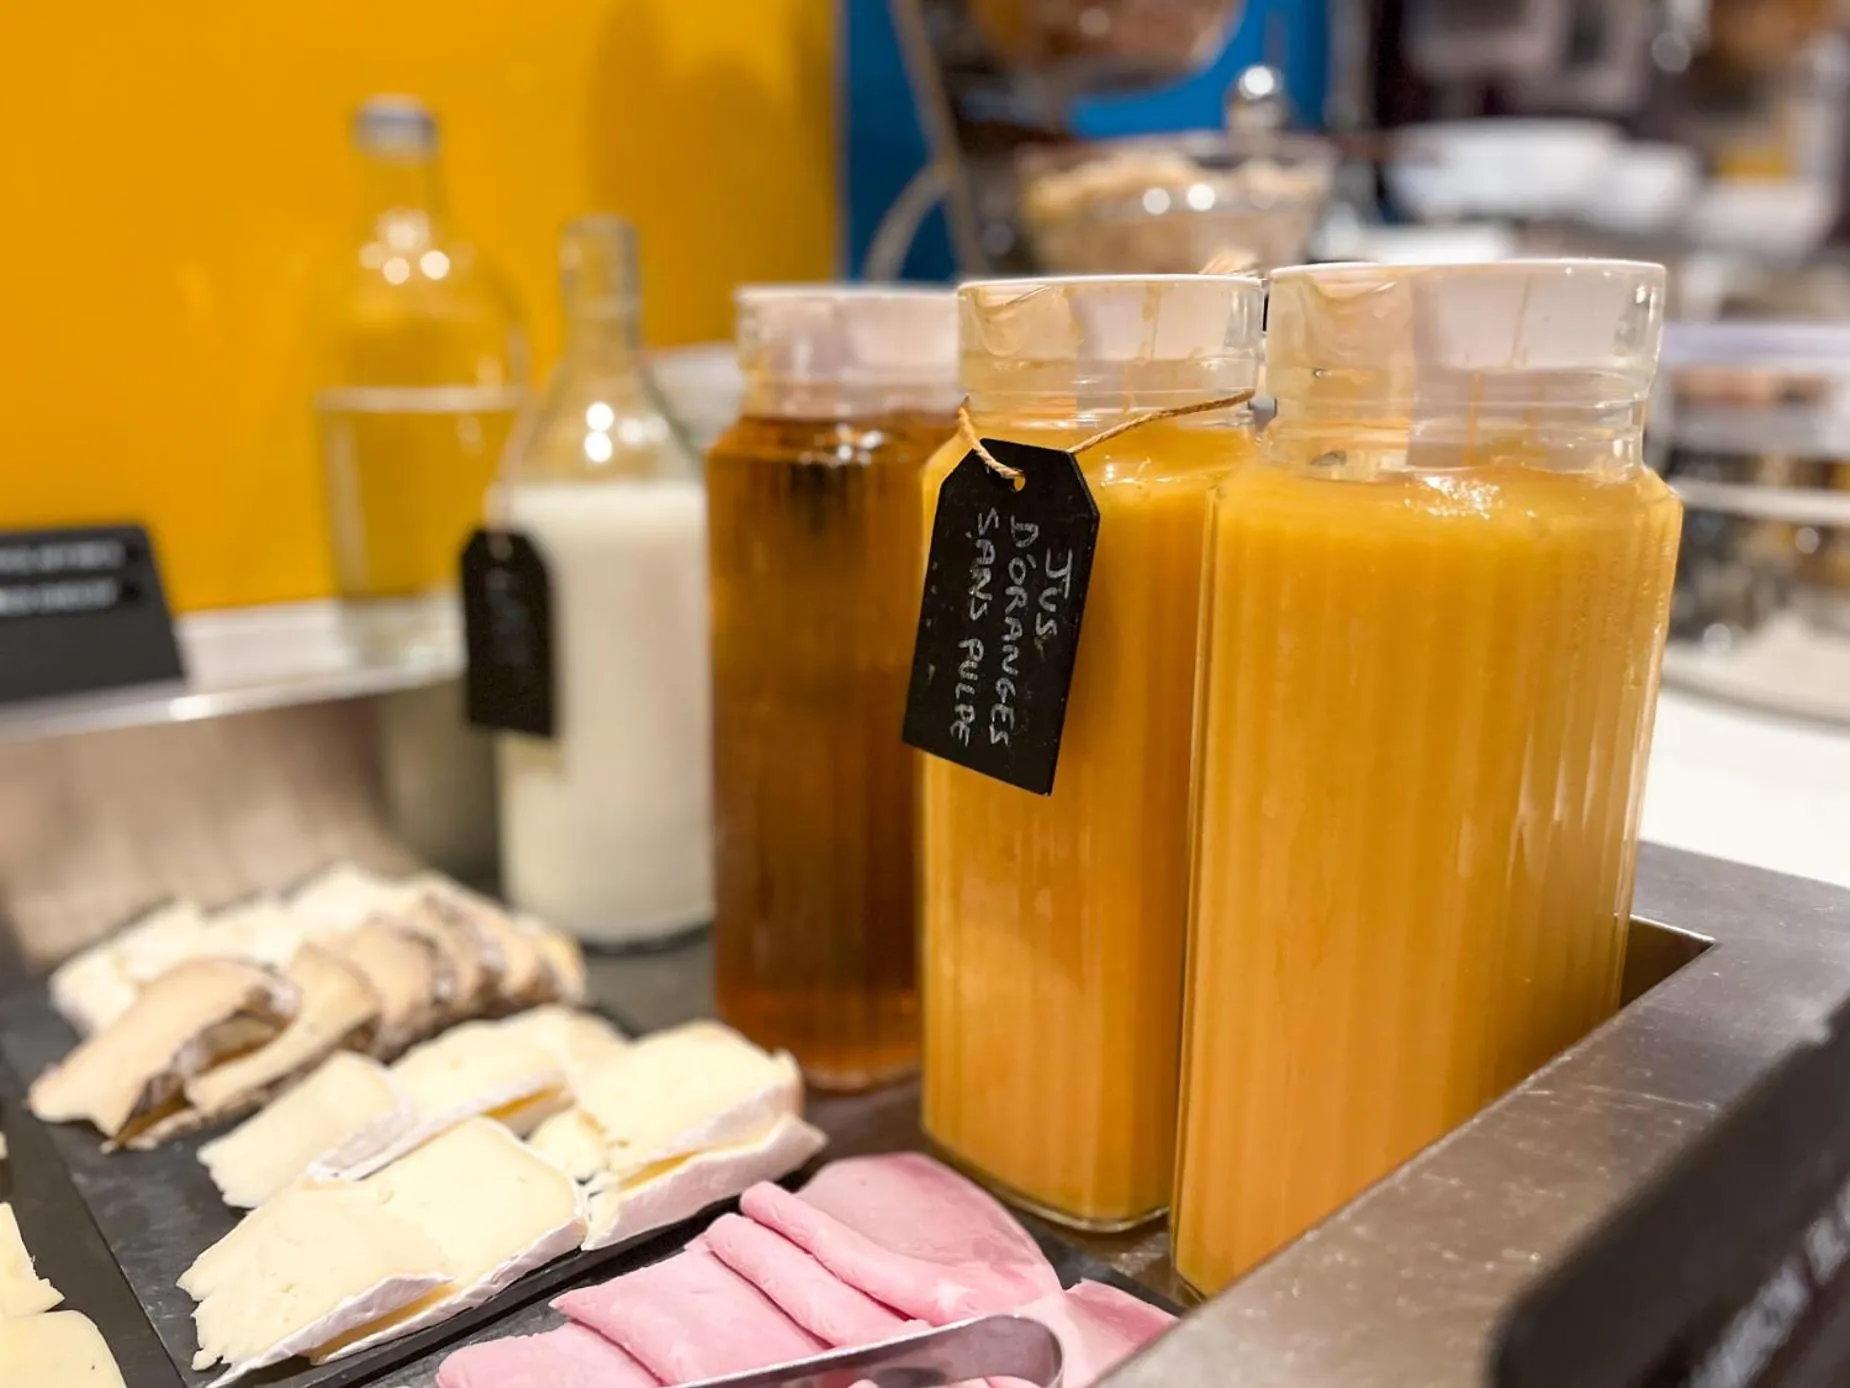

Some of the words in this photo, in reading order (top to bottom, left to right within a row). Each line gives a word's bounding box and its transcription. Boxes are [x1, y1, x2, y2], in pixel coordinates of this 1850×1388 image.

[968, 507, 1000, 621] SANS
[1035, 547, 1073, 636] JUS
[989, 514, 1040, 746] D'ORANGES
[950, 637, 984, 747] PULPE
